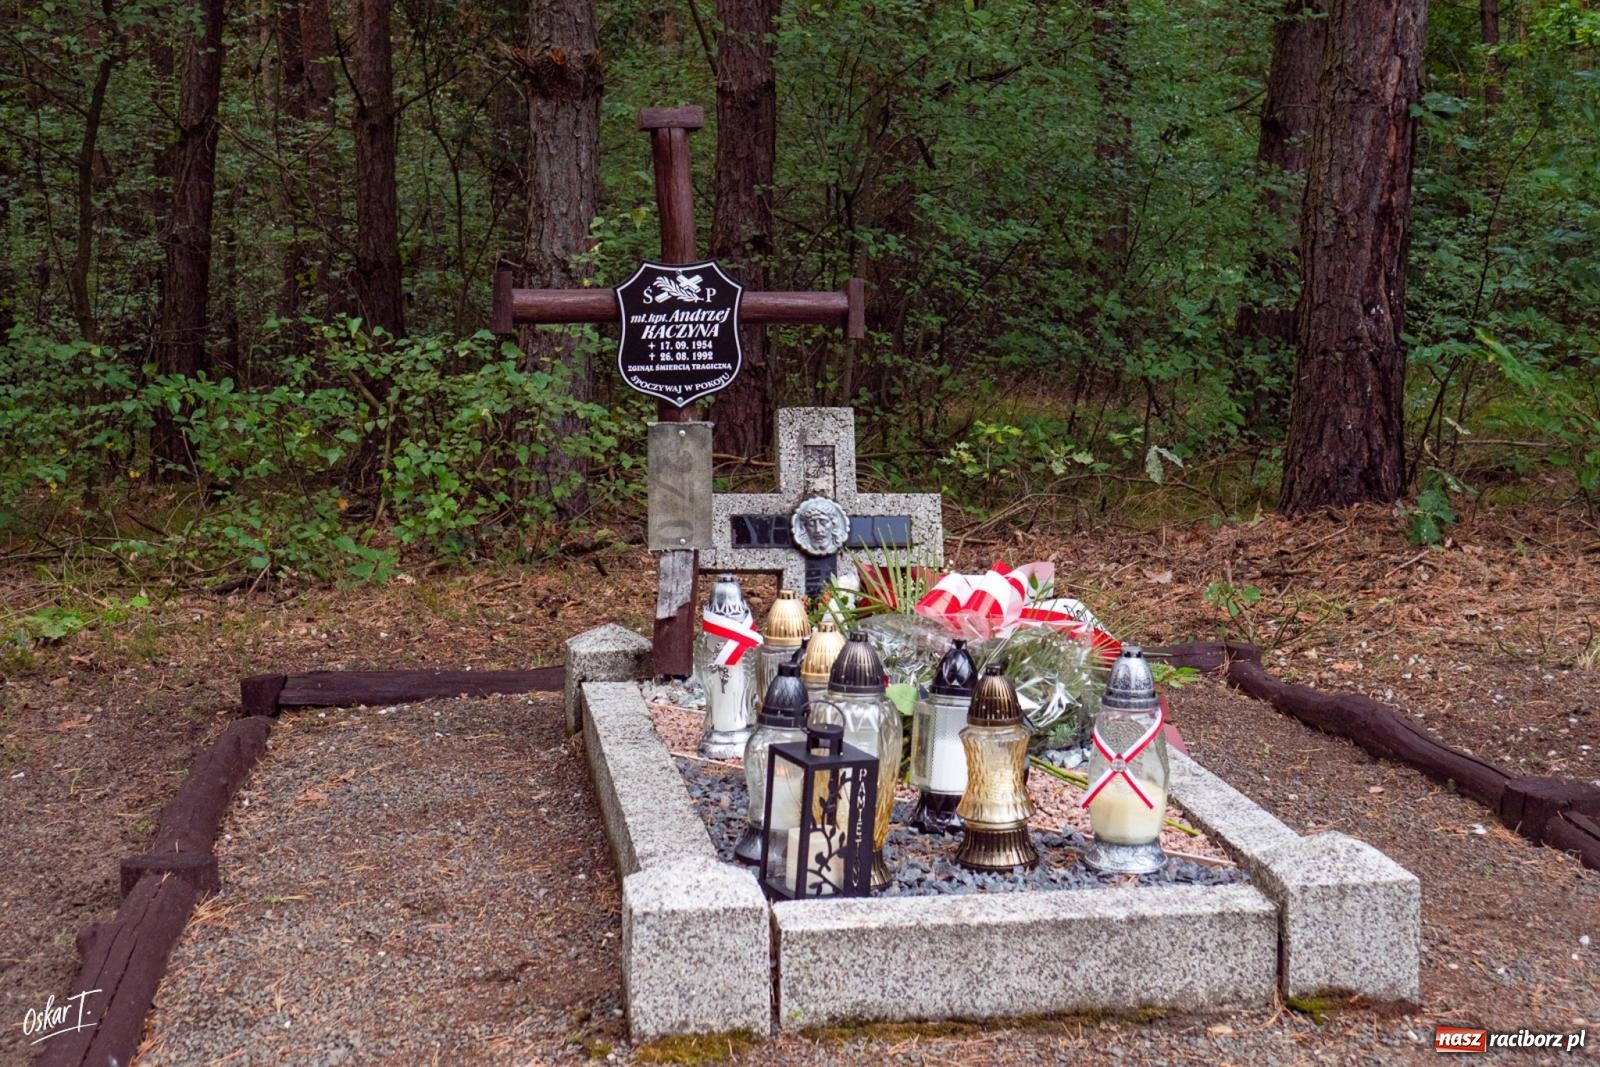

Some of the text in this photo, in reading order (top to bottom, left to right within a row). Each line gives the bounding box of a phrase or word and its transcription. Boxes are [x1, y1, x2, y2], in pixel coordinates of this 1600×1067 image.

[705, 287, 717, 303] P
[668, 307, 731, 324] Andrzej
[641, 323, 720, 339] KACZYNA
[692, 340, 713, 350] 1954
[692, 351, 713, 361] 1992
[655, 363, 690, 372] ŚMIERCIĄ
[692, 363, 732, 371] TRAGICZNĄ
[630, 375, 682, 394] SPOCZYWAJ
[694, 372, 730, 391] POKOJU
